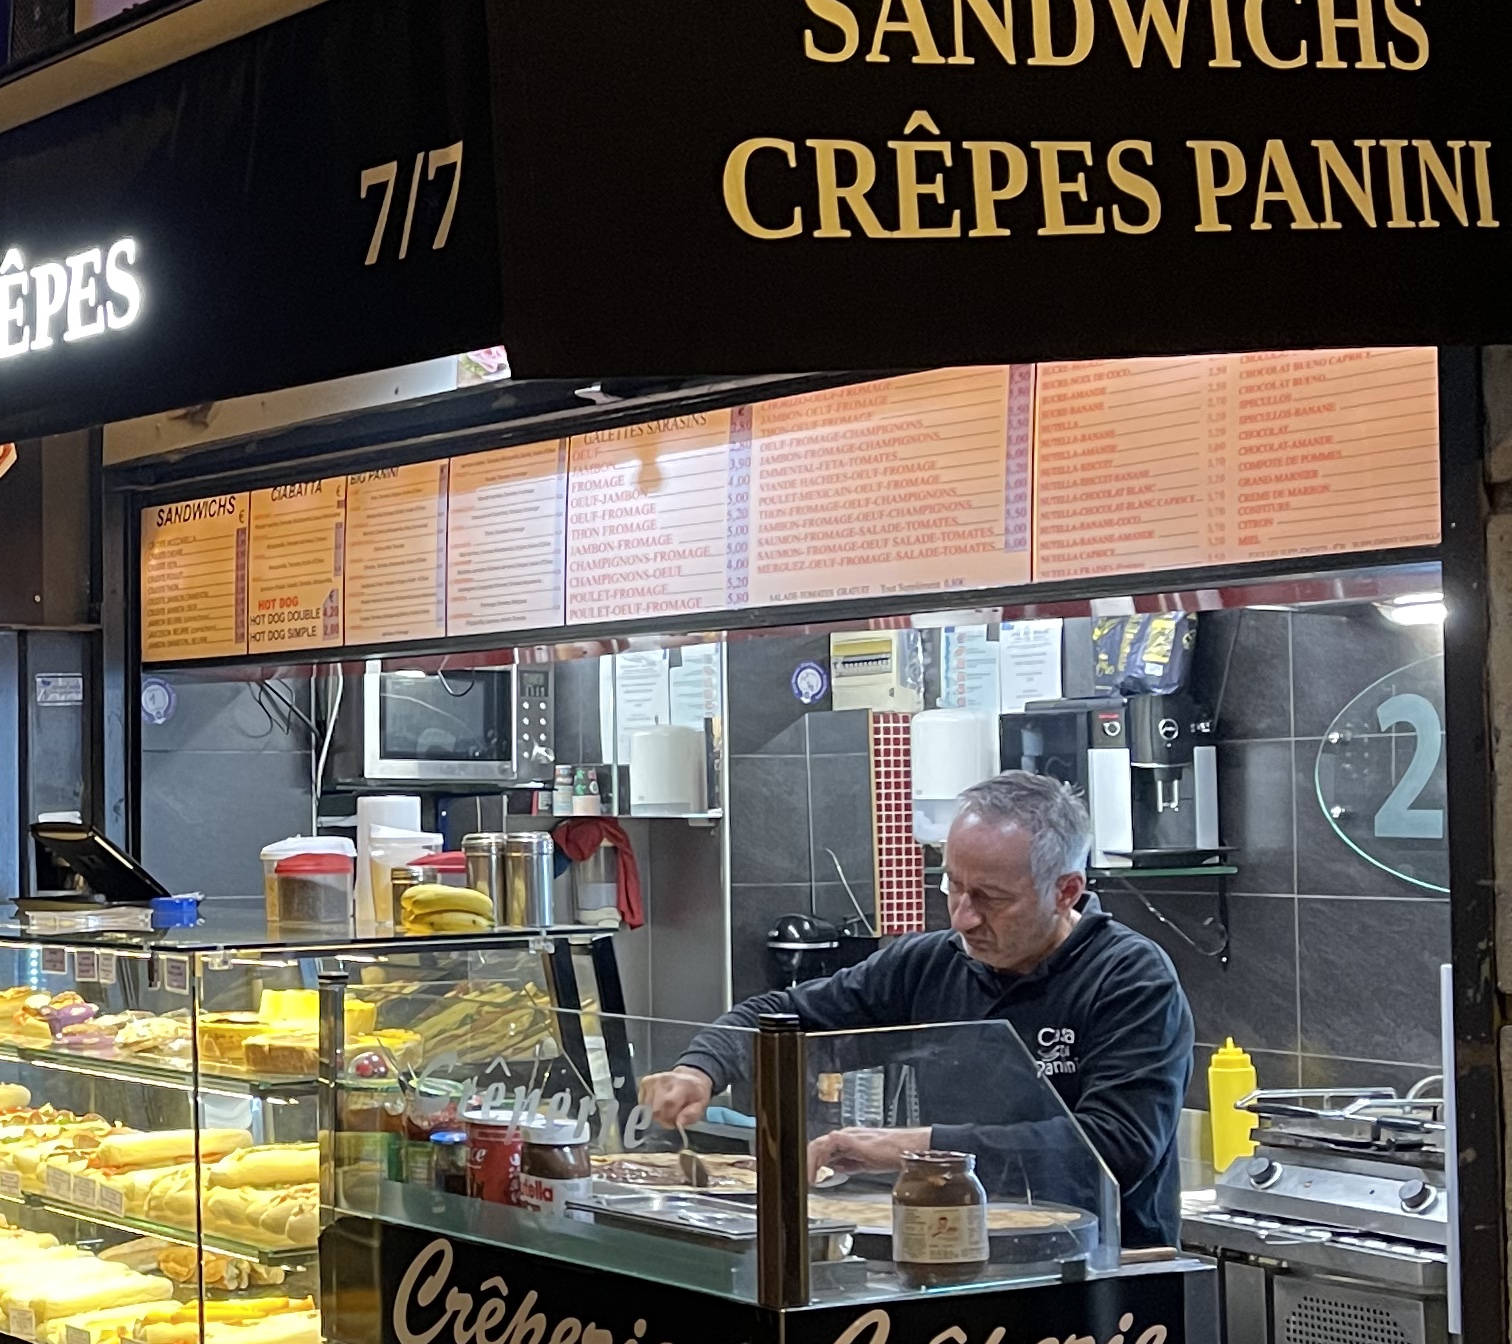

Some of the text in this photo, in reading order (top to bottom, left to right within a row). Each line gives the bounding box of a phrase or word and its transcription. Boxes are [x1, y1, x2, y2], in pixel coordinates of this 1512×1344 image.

[721, 109, 1500, 240] CRÊPES PANINI
[359, 140, 464, 266] 7/7
[572, 475, 624, 493] FROMAGE
[156, 496, 236, 528] SANDWICHS
[571, 503, 656, 524] OEUF-FROMAGE
[571, 526, 599, 540] THON
[602, 520, 656, 536] FROMAGE
[571, 534, 673, 556] JAMBON-FROMAGE
[258, 598, 276, 611] HOT
[279, 596, 299, 608] DOG
[250, 615, 267, 626] HOT
[267, 612, 286, 624] DOG
[287, 608, 321, 623] DOUBLE
[250, 631, 267, 643] HOT
[267, 628, 286, 641] DOG
[1375, 693, 1444, 839] 2
